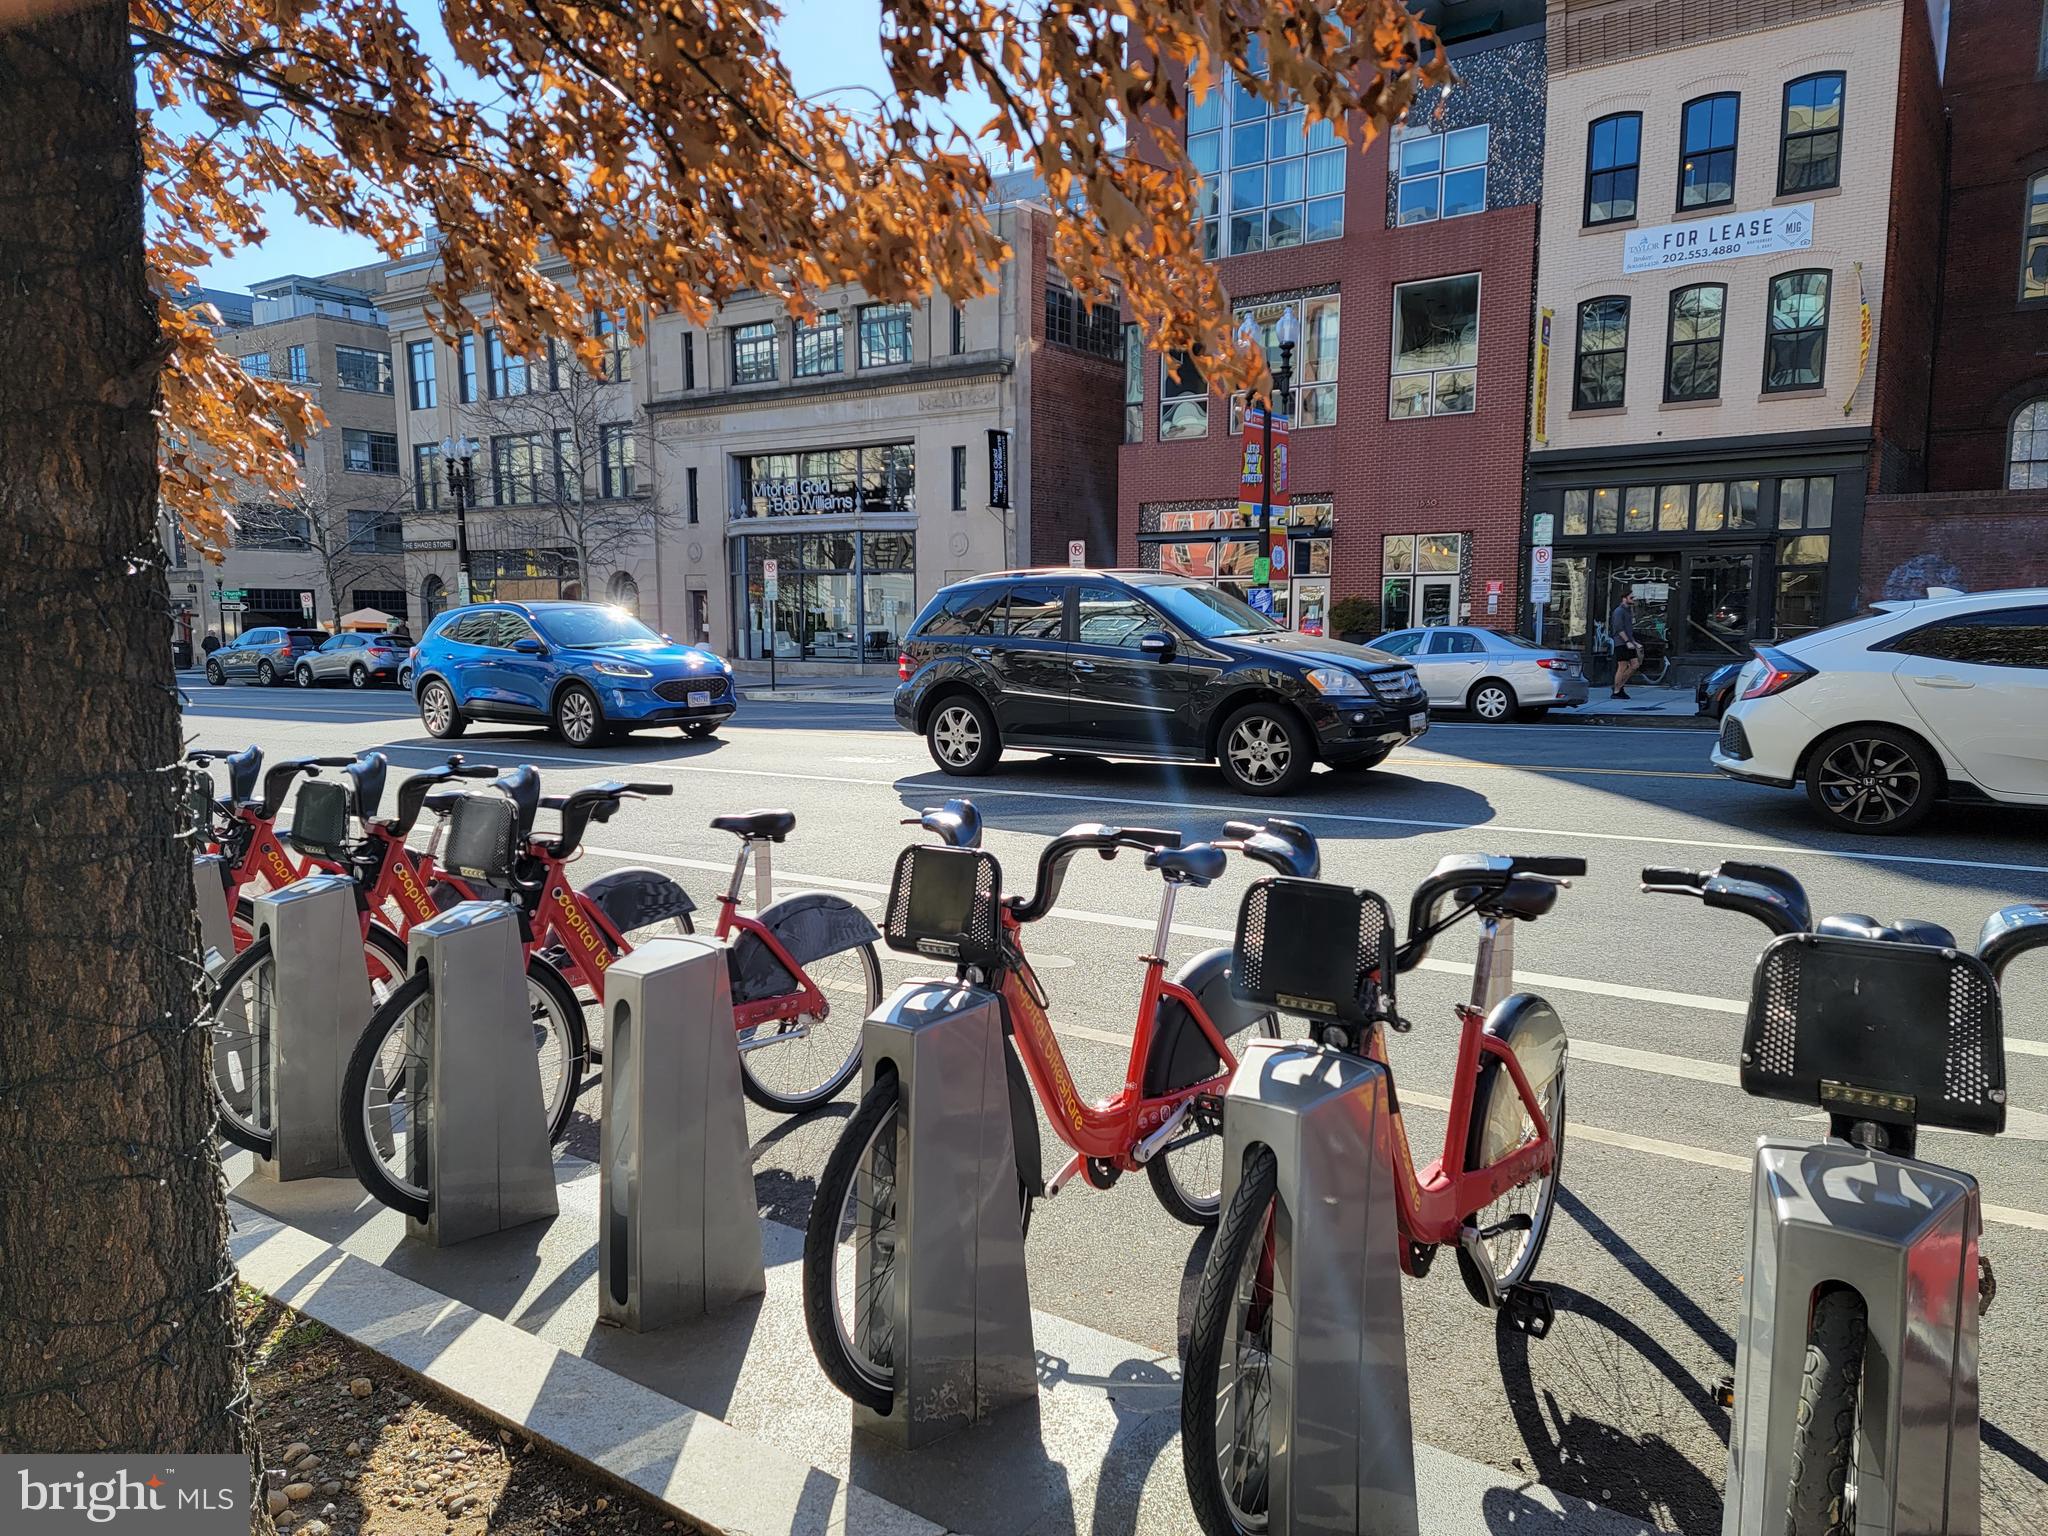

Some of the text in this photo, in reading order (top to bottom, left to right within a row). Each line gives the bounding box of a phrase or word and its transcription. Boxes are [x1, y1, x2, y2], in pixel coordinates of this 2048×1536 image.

[1663, 218, 1773, 250] FOR LEASE
[1785, 221, 1802, 235] MJG
[1630, 242, 1660, 254] TAYLOR
[1662, 243, 1741, 264] 202.553.4880
[752, 479, 830, 497] Mitchell Gold
[1241, 474, 1263, 483] STREETS
[767, 495, 853, 512] +Bob Williams
[398, 870, 435, 921] capital
[558, 894, 611, 972] capital bi
[1044, 1035, 1083, 1131] bikeshare
